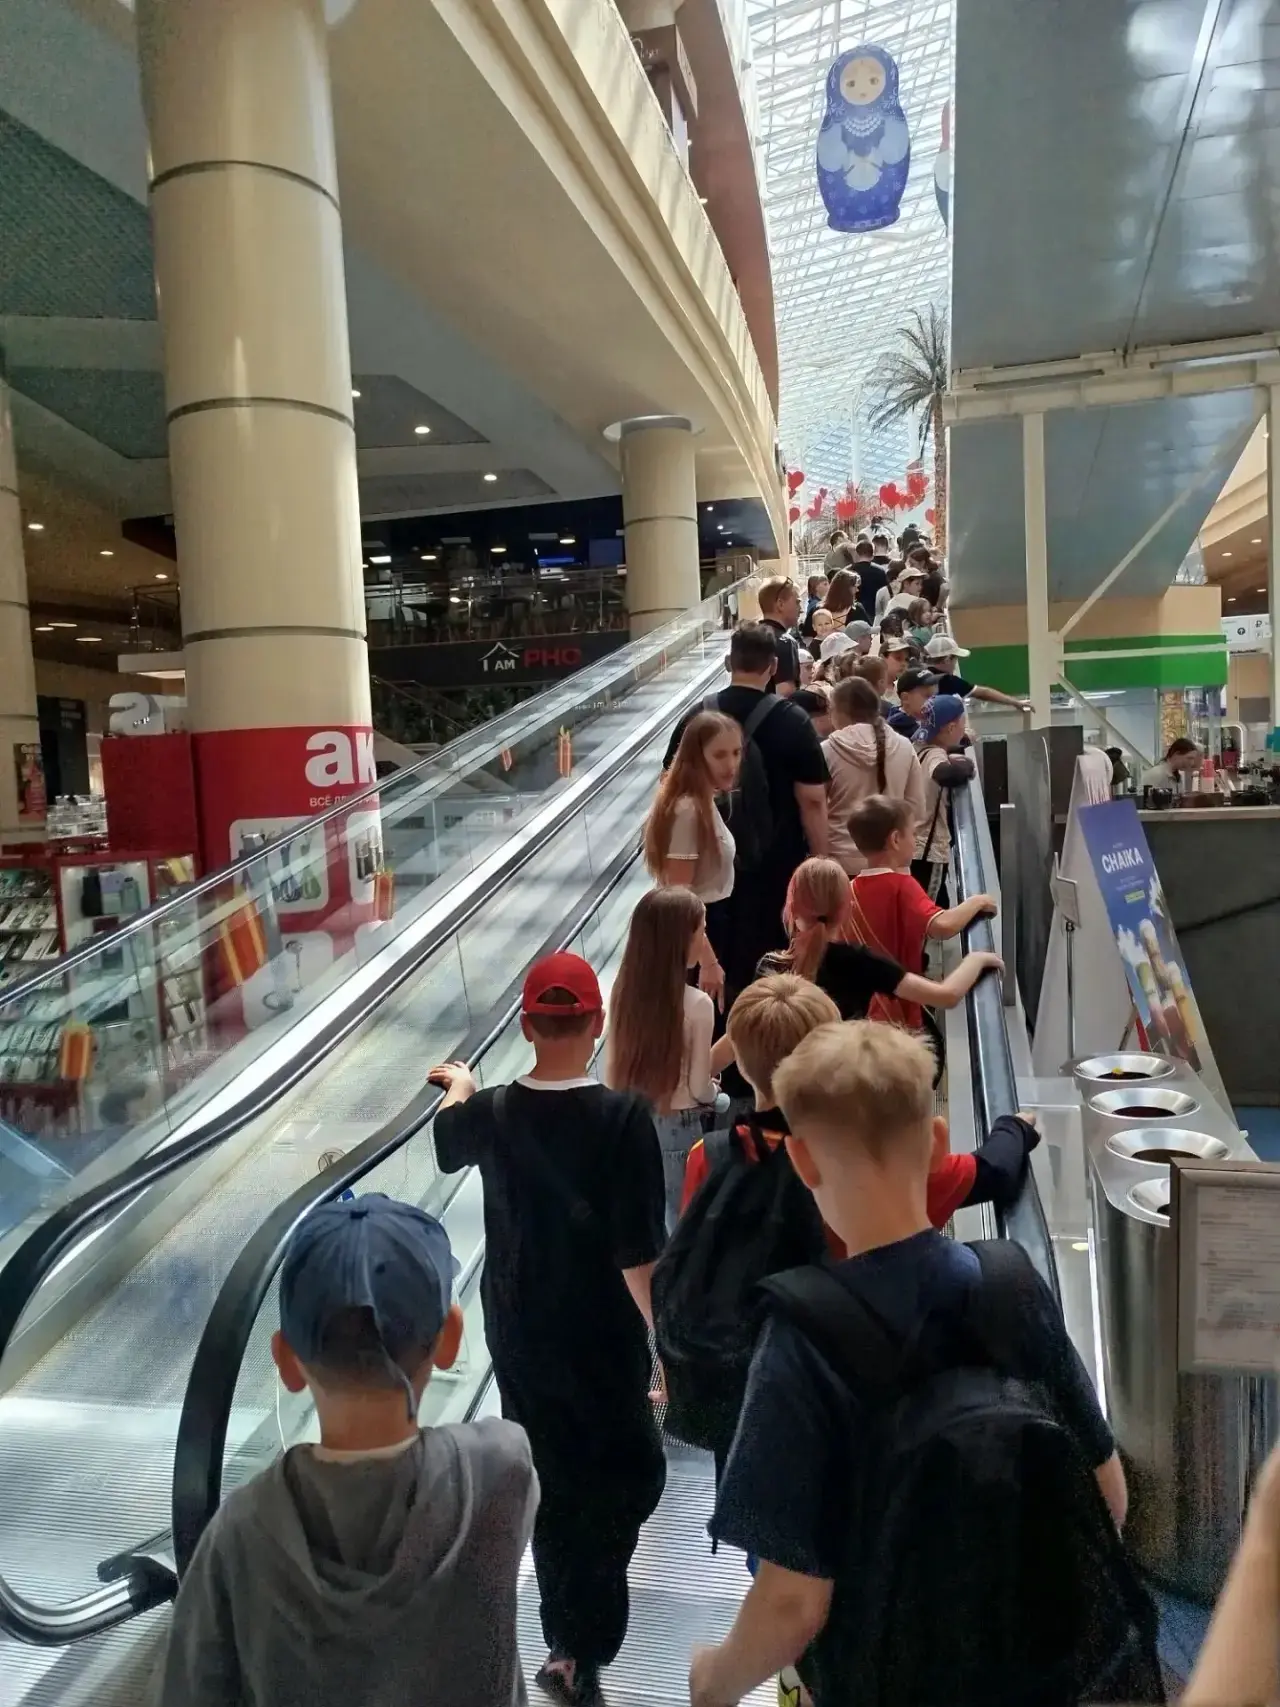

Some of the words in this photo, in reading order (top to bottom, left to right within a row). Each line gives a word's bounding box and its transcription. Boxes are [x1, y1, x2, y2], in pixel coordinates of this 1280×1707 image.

[494, 659, 516, 670] AM
[523, 648, 582, 668] PHO
[1101, 847, 1144, 874] CHAIKA
